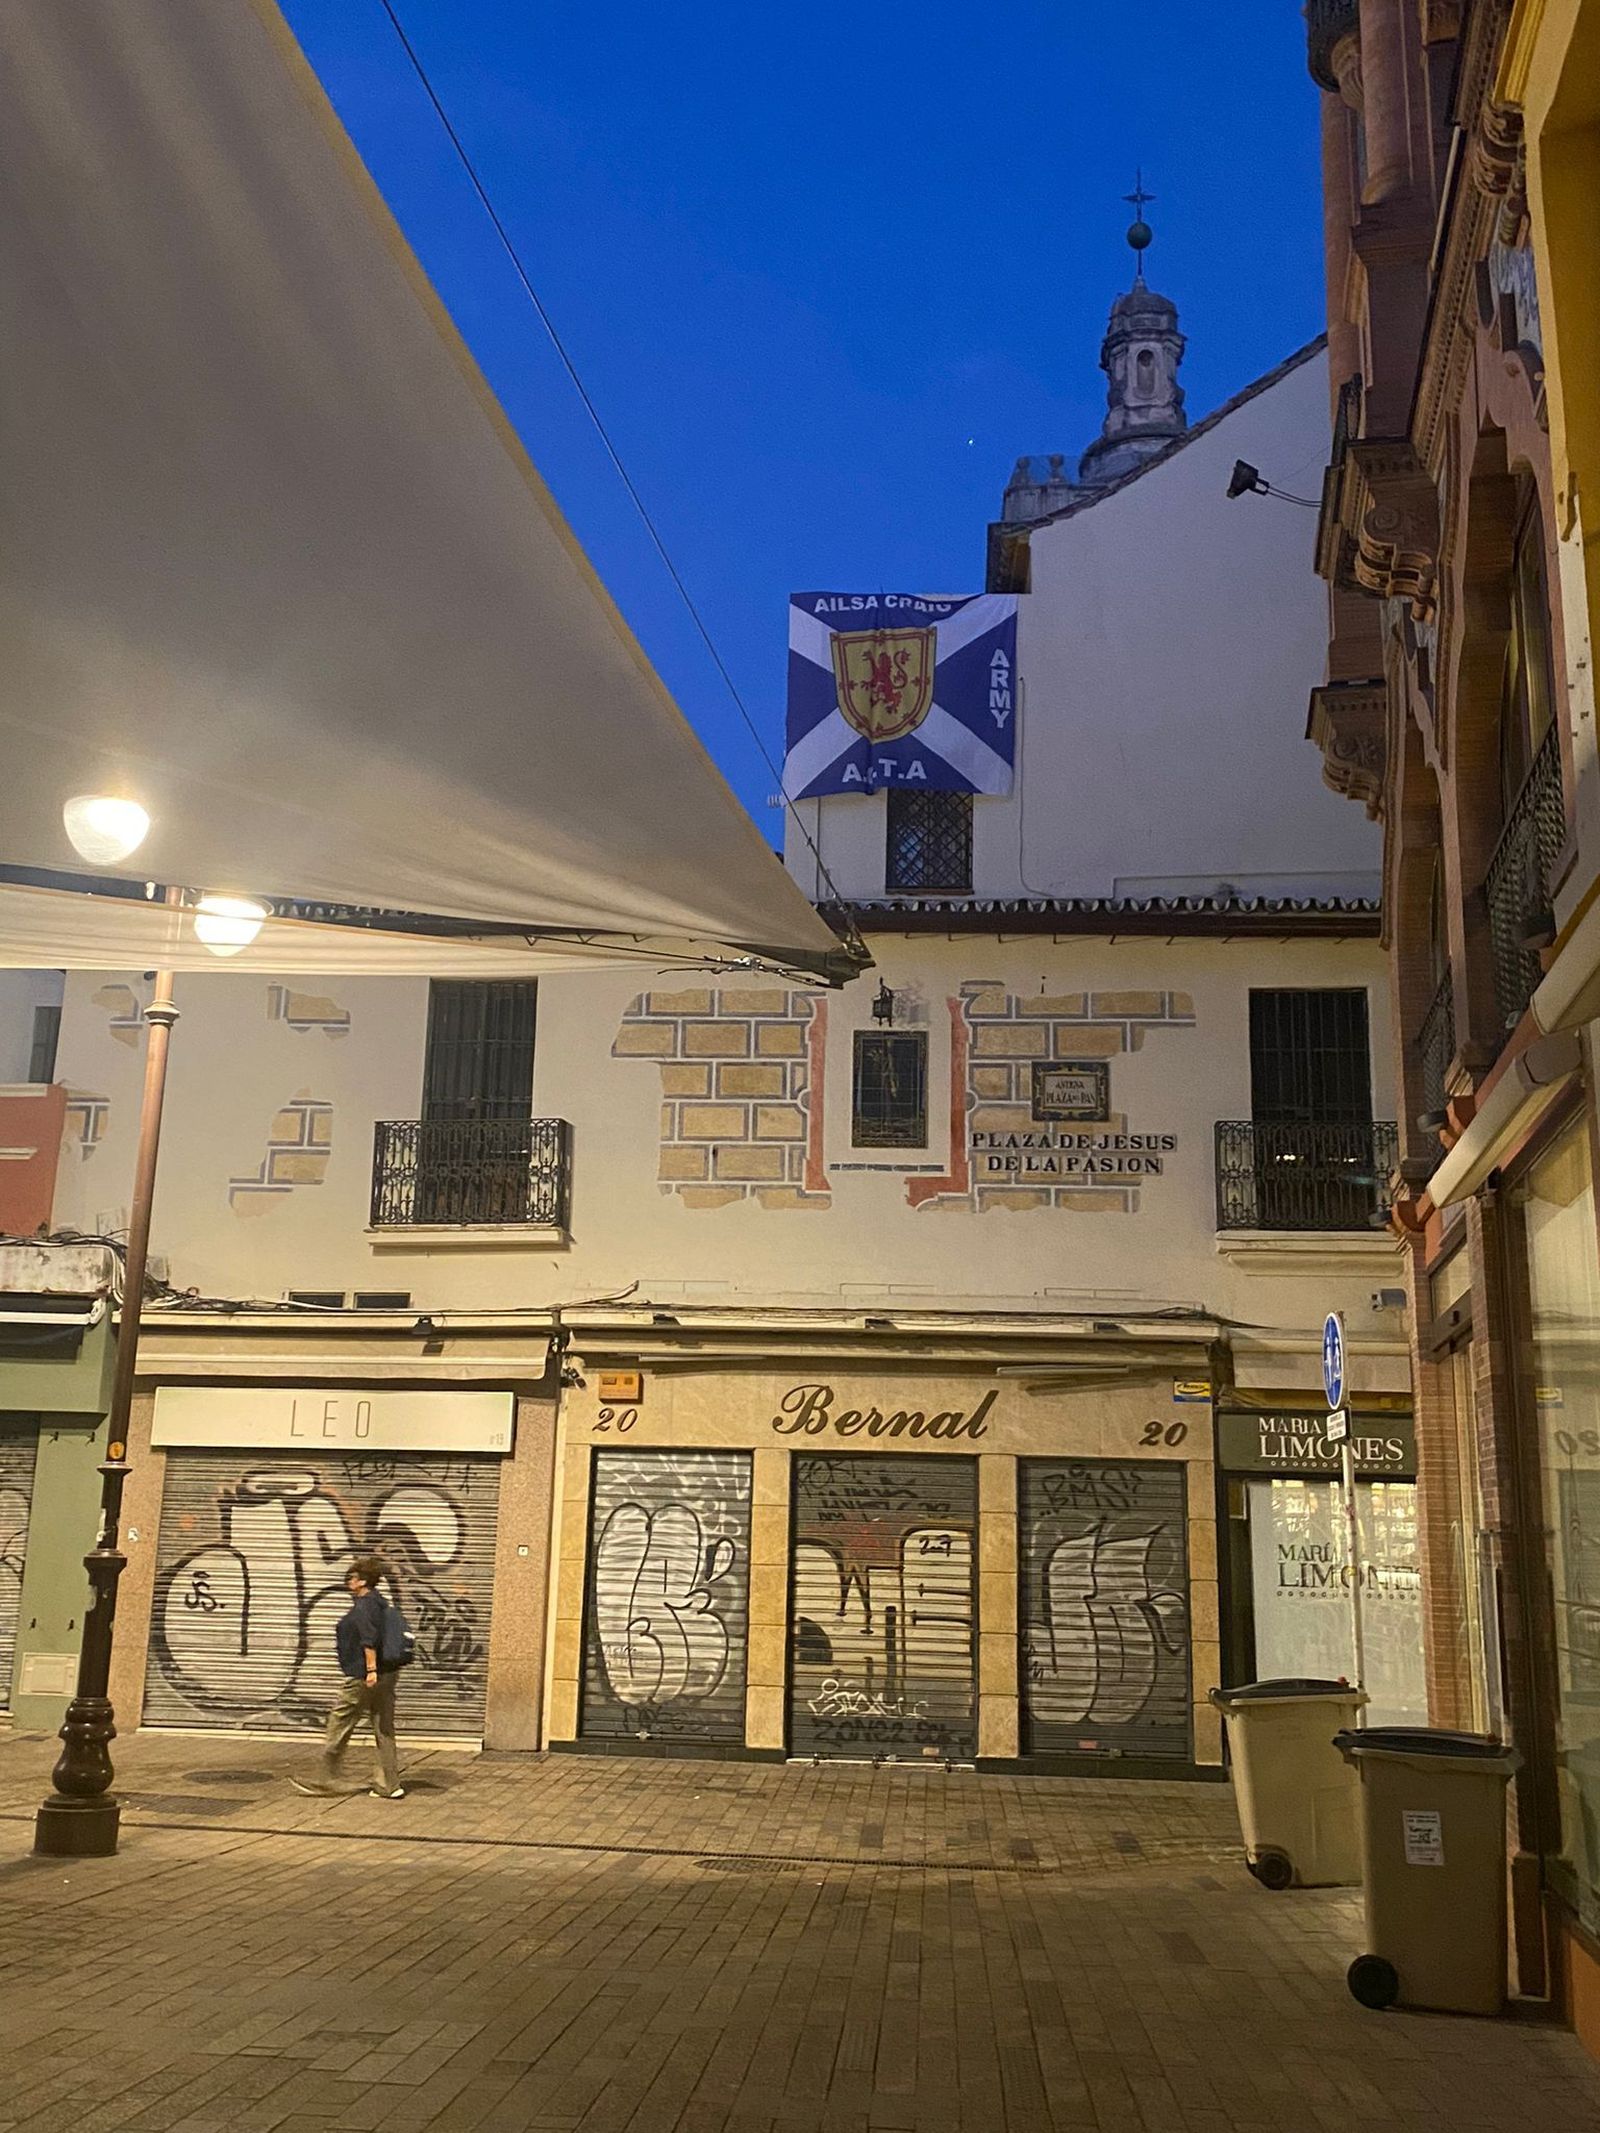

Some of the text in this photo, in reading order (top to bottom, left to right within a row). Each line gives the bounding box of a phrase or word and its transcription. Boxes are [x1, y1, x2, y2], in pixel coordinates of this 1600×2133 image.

[814, 595, 879, 613] AILSA
[989, 648, 1012, 729] ARMY
[972, 1132, 1175, 1150] PLAZA DE JESUS
[988, 1155, 1019, 1172] DE
[1025, 1156, 1057, 1172] LA
[290, 1399, 371, 1438] LEO
[591, 1407, 638, 1432] 20
[772, 1384, 1000, 1439] Bernal
[1138, 1420, 1188, 1447] 20
